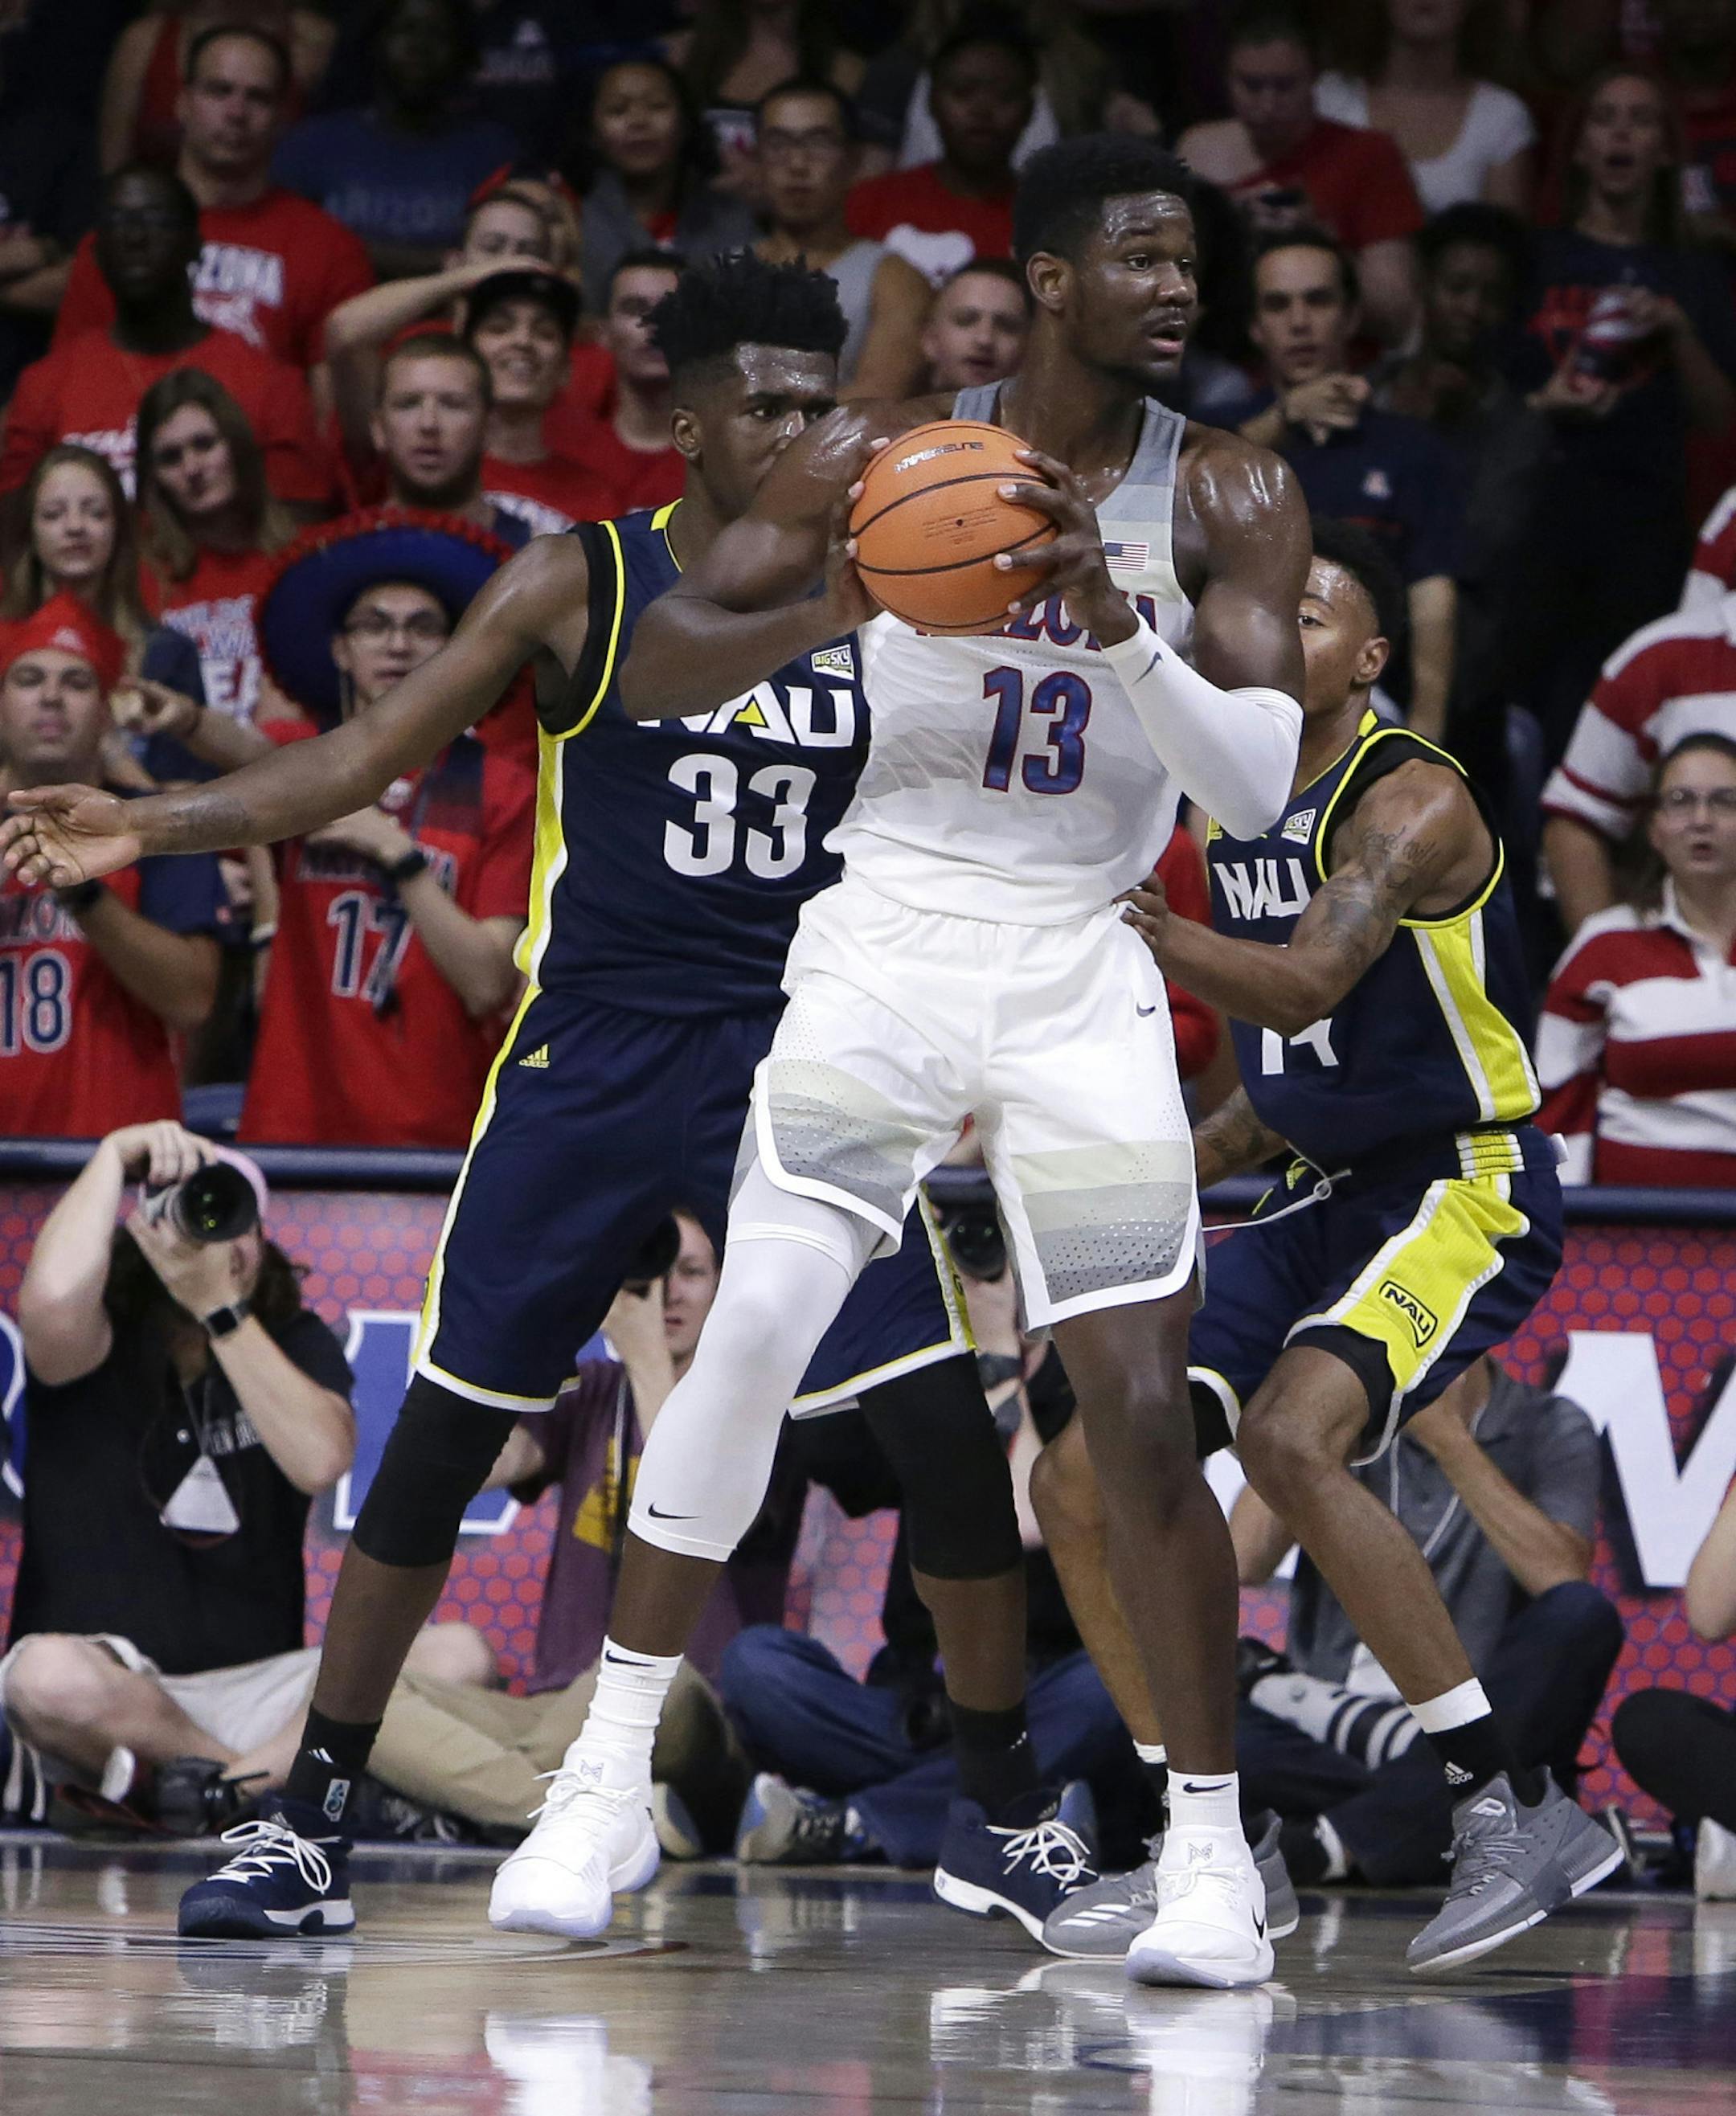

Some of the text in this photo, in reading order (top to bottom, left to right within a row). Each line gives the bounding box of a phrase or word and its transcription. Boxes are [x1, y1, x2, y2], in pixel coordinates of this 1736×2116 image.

[637, 681, 855, 747] AU
[982, 665, 1092, 795] 13
[663, 753, 817, 879] 33
[1212, 857, 1312, 921] NAU
[0, 948, 73, 1057] 18
[326, 890, 414, 1007] 17
[1384, 1287, 1431, 1336] NAU
